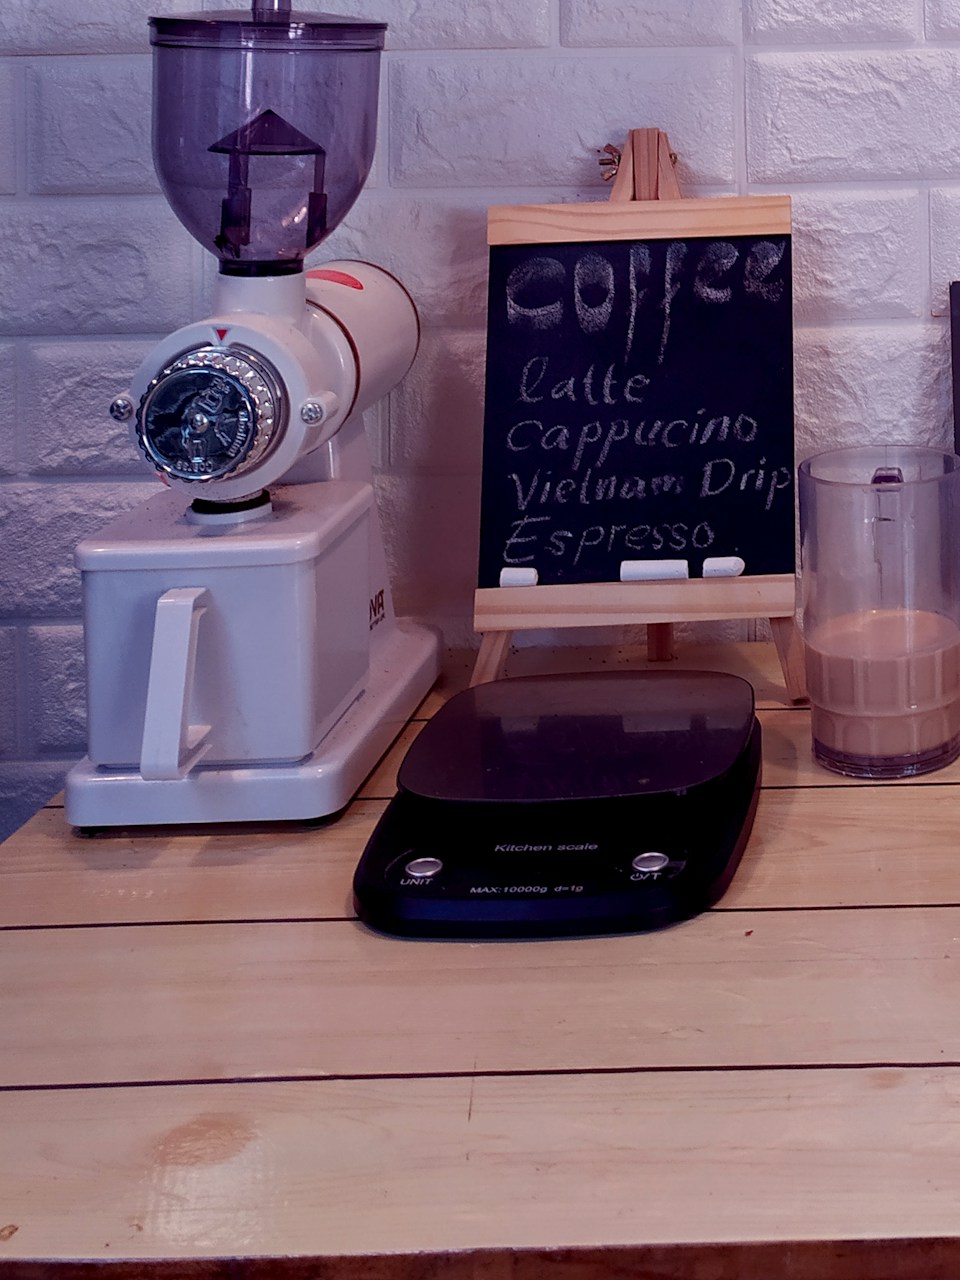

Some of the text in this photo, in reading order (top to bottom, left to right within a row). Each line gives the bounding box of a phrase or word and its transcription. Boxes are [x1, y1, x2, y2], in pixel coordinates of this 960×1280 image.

[699, 457, 792, 510] Drip
[503, 516, 715, 566] Espresso
[494, 842, 598, 852] Kitchen scale
[400, 878, 433, 886] UNIT
